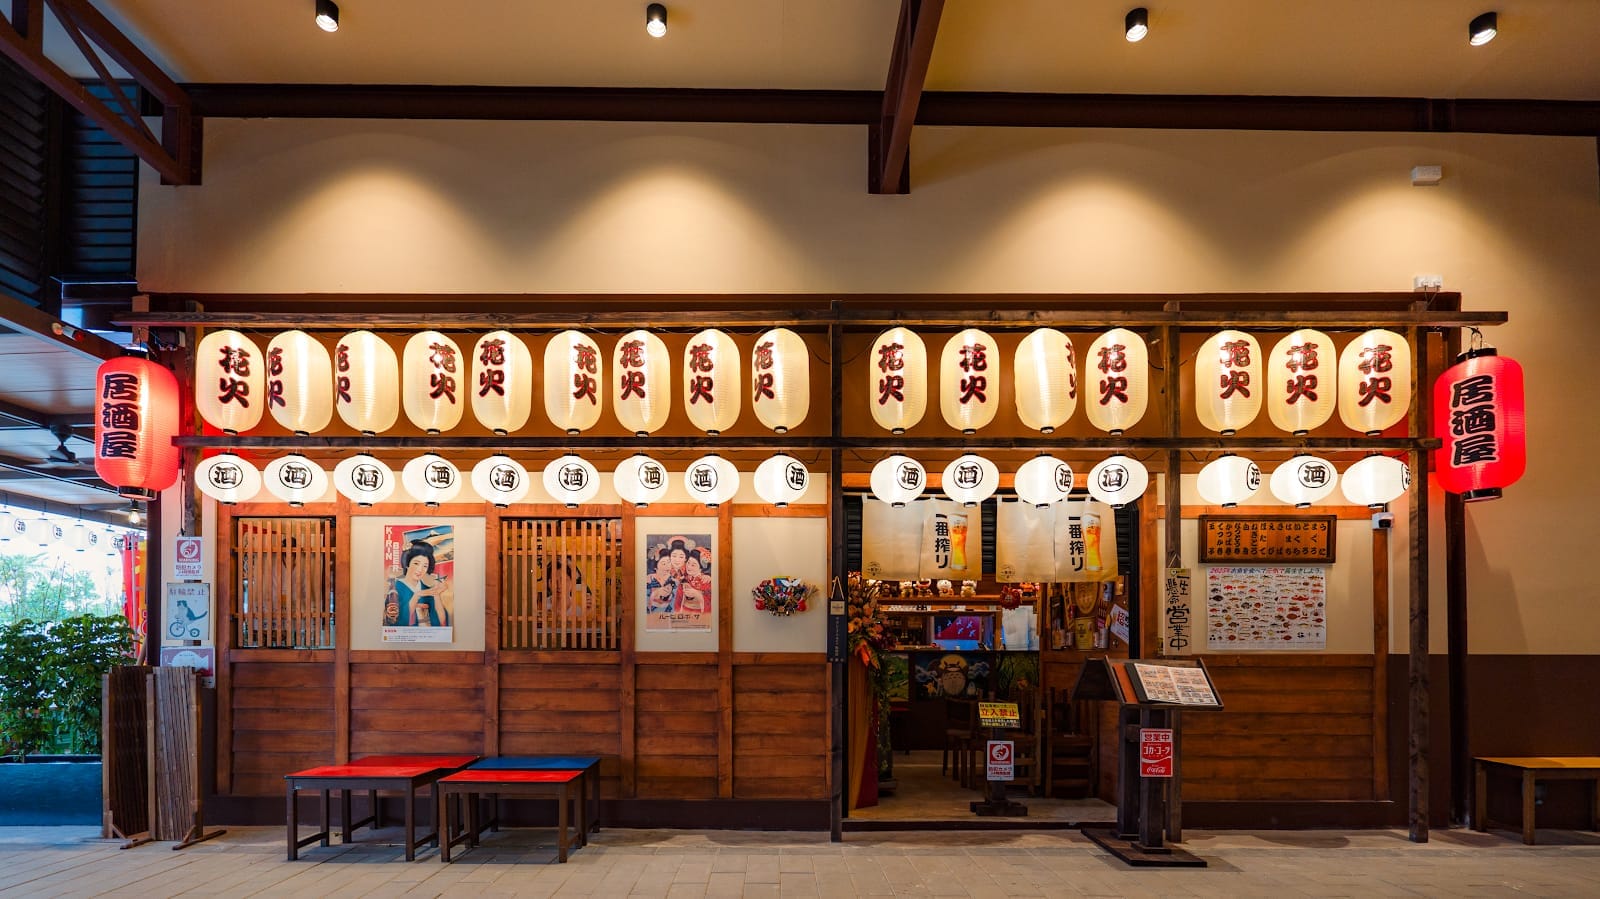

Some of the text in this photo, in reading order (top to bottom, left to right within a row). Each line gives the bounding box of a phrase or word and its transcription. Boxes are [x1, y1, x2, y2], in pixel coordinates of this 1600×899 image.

[218, 345, 251, 408] 花火
[429, 342, 457, 405] 花火
[479, 339, 505, 398] 花火
[573, 343, 597, 405] 花火
[620, 340, 646, 399] 花火
[689, 344, 714, 404] 花火
[753, 341, 775, 402] 花火
[878, 343, 905, 406] 花火
[959, 343, 987, 404] 花火
[1097, 343, 1129, 406] 花火
[1220, 339, 1251, 399] 花火
[1285, 342, 1319, 405] 花火
[1358, 344, 1393, 407] 花火
[101, 373, 139, 459] 居酒屋
[1451, 375, 1499, 466] 居酒屋
[214, 467, 237, 484] 酒
[284, 465, 307, 483] 酒
[357, 468, 379, 487] 酒
[431, 465, 450, 484] 酒
[495, 468, 515, 487] 酒
[563, 468, 583, 486] 酒
[644, 466, 661, 485] 酒
[694, 469, 714, 486] 酒
[790, 466, 805, 486] 酒
[901, 466, 920, 486] 酒
[957, 465, 978, 484] 酒
[1059, 468, 1072, 487] 酒
[1102, 469, 1124, 487] 酒
[1304, 465, 1326, 484] 酒
[385, 526, 393, 560] KIRIN
[392, 541, 400, 572] BEER
[935, 513, 950, 569] 一番搾り
[1068, 516, 1085, 572] 一番搾り
[169, 588, 205, 596] 駐輪禁止
[1166, 604, 1191, 650] 営業中
[981, 707, 1017, 717] 立入禁止
[1145, 733, 1170, 741] 営業中
